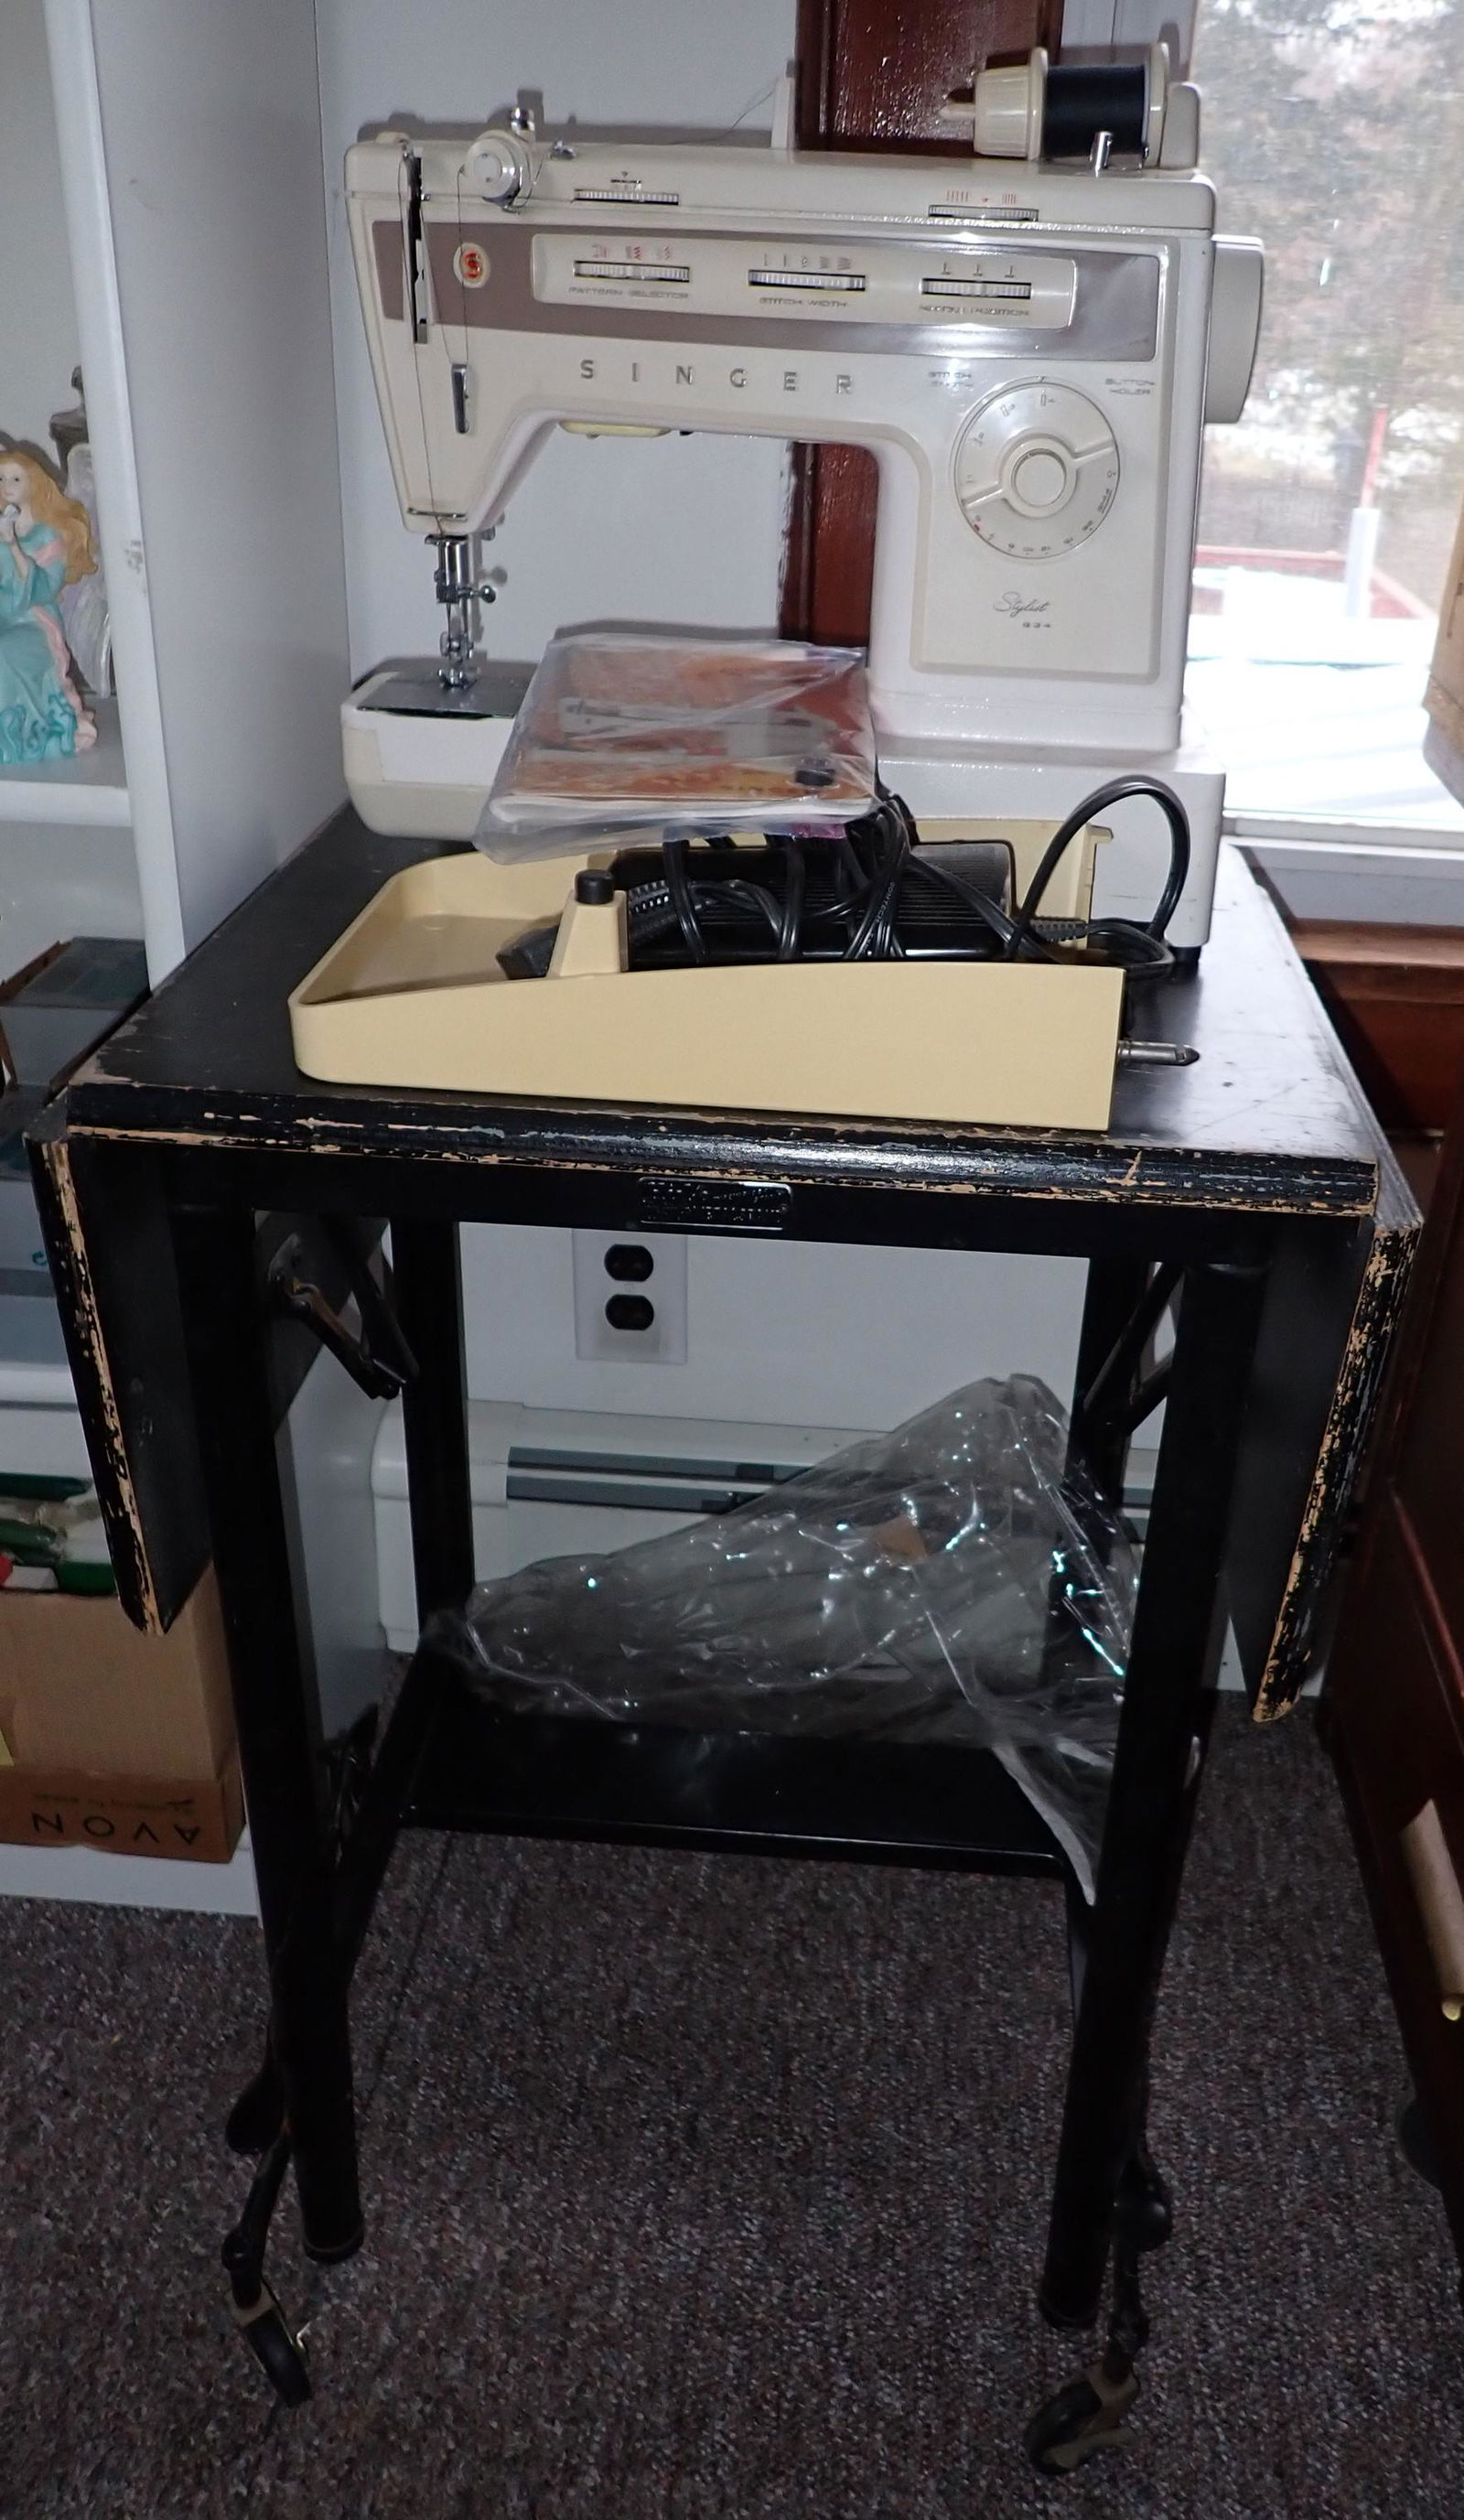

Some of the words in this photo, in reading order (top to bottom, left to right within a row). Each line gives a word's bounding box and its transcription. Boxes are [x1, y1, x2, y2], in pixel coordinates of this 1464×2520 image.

[579, 359, 853, 395] SINGER
[993, 590, 1050, 618] Stylist
[31, 1811, 200, 1846] AVON
